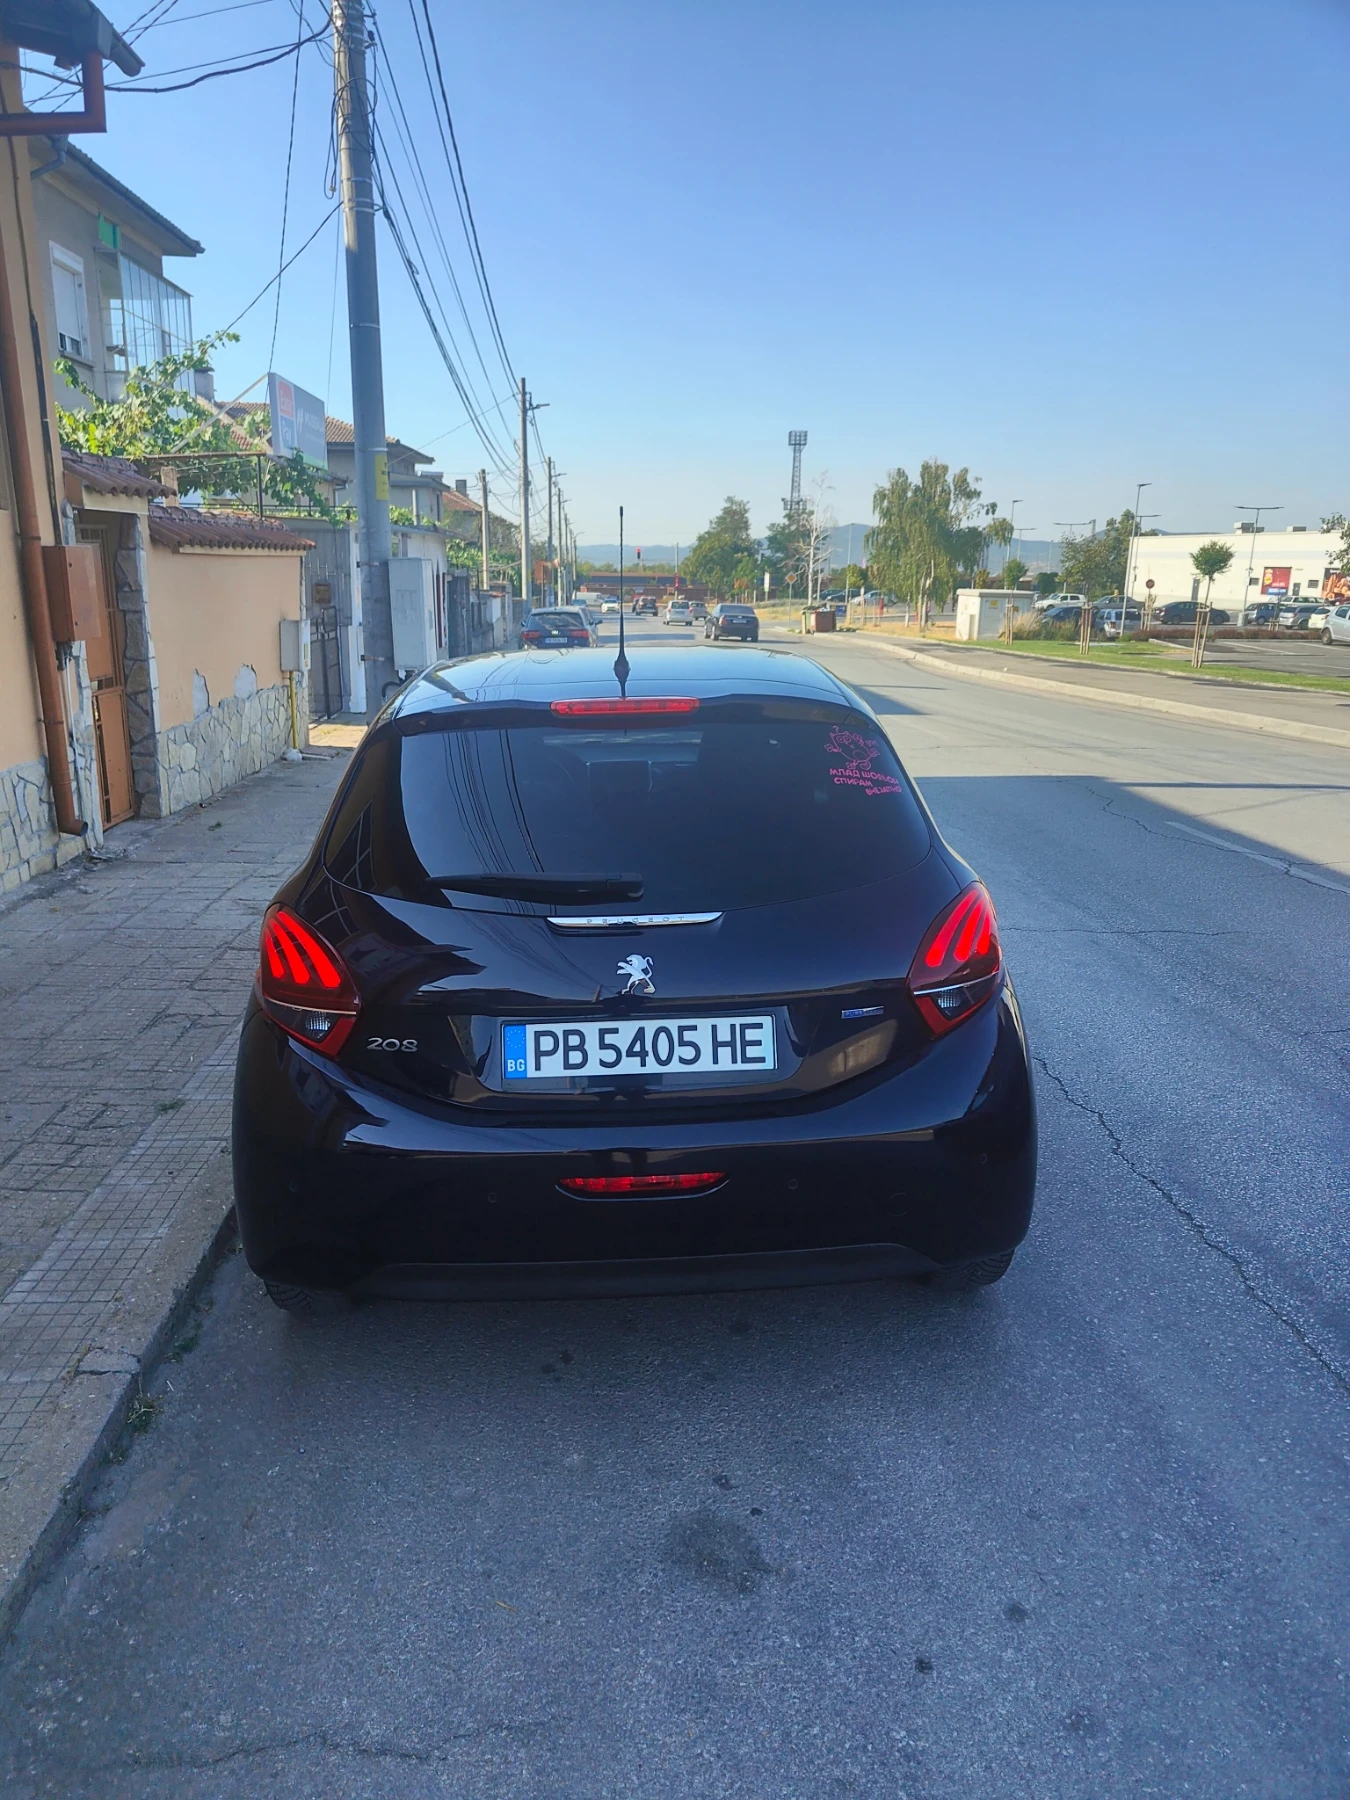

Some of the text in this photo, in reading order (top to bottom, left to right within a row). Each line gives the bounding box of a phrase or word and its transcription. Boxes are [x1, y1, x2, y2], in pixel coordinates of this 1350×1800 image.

[281, 418, 293, 446] Pay
[829, 768, 860, 778] МЛАД
[833, 777, 873, 787] СПИРАМ
[586, 916, 685, 926] PEUGEOT
[367, 1037, 418, 1052] 208
[533, 1023, 766, 1071] PB 5405 HE
[507, 1058, 525, 1072] BG
